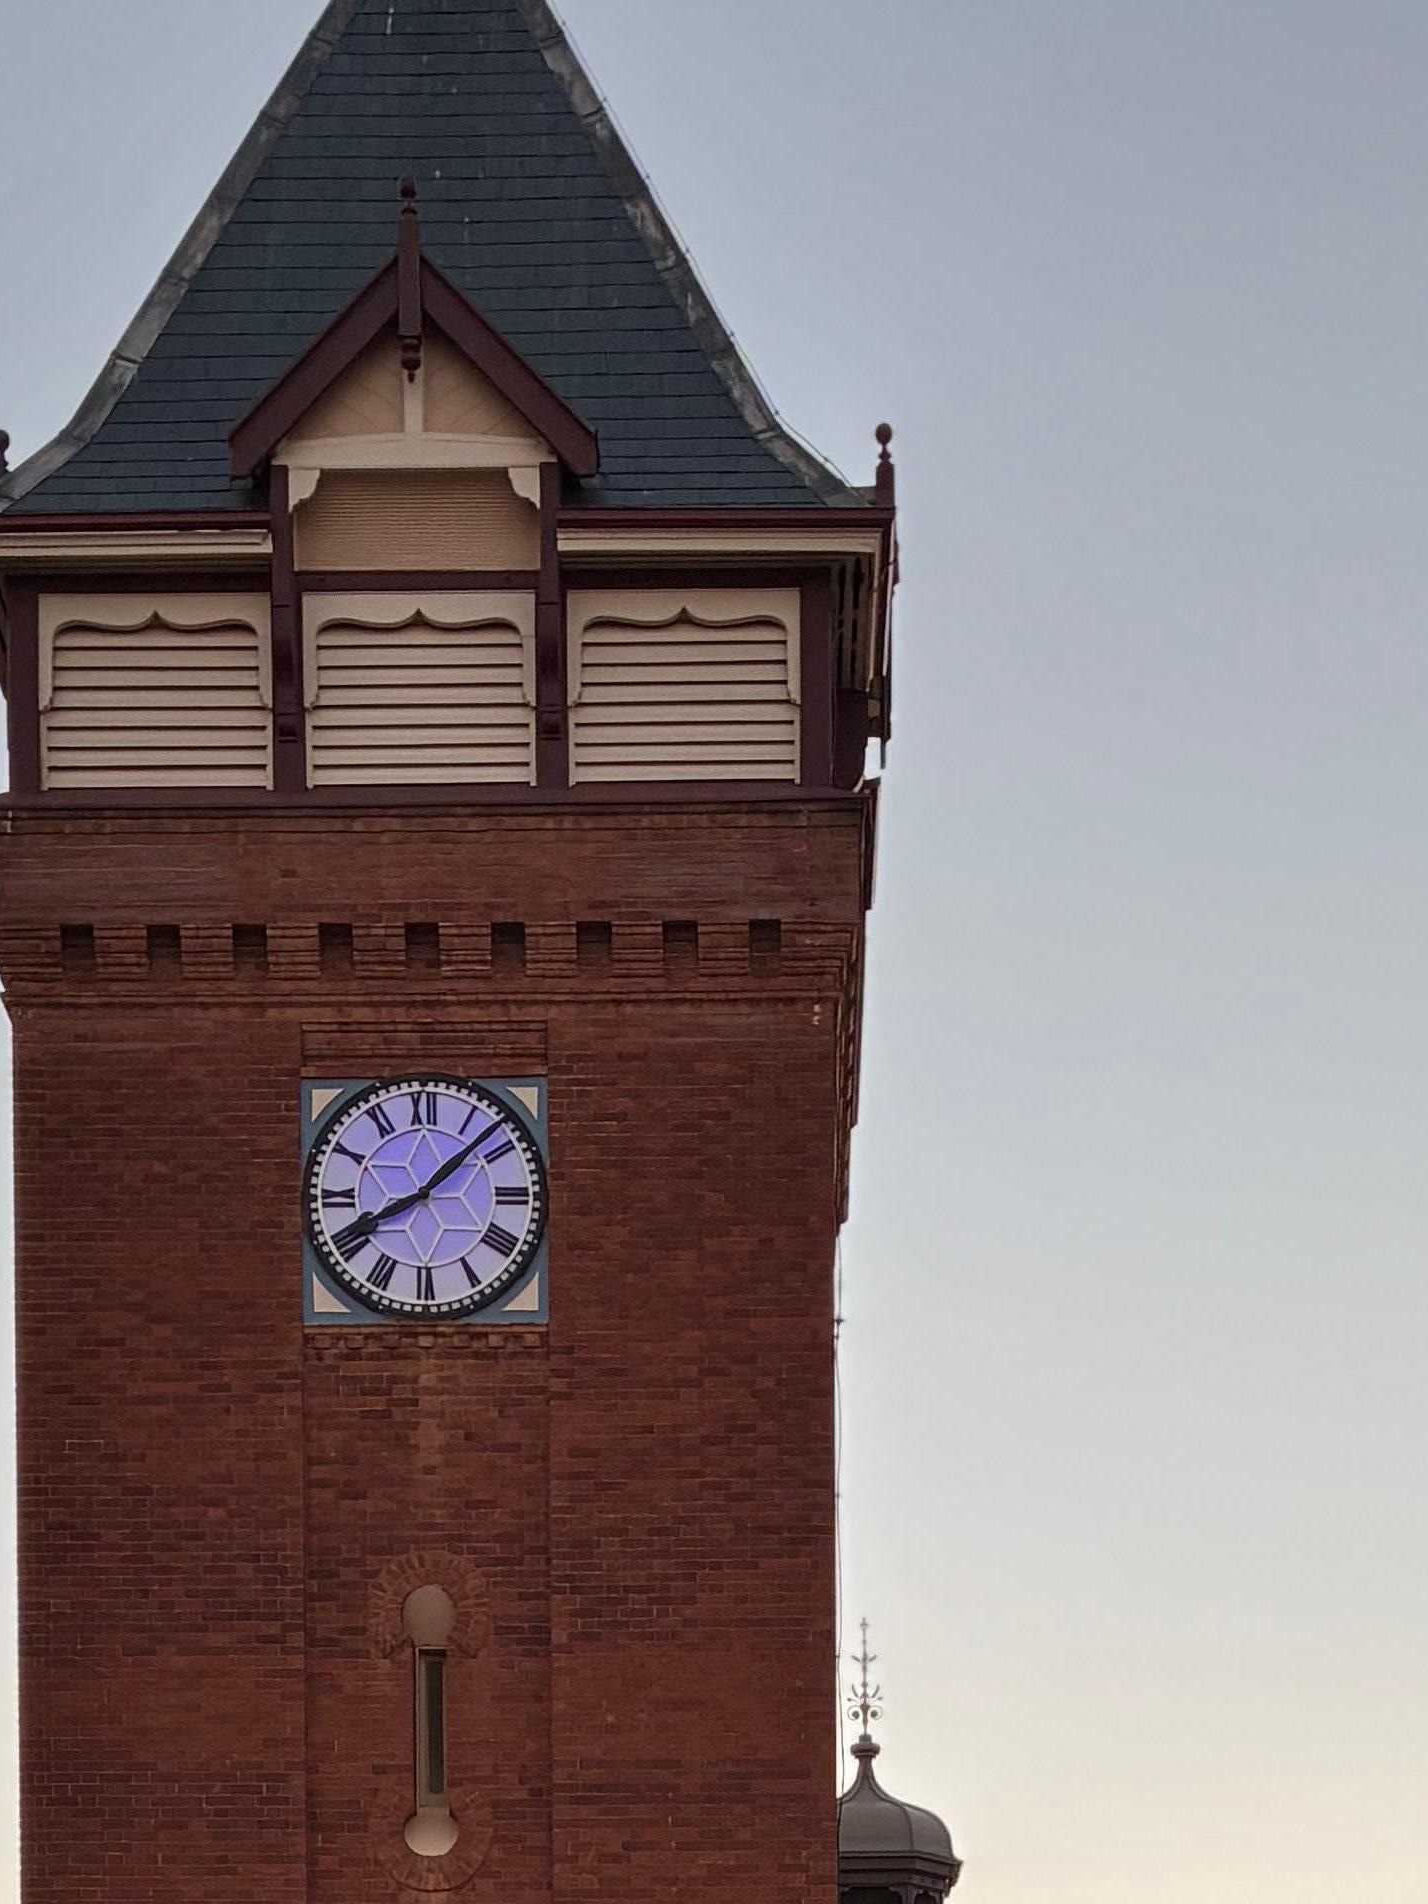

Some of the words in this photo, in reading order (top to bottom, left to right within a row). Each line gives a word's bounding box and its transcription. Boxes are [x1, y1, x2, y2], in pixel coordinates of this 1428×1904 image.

[365, 1103, 396, 1139] XI
[410, 1092, 437, 1126] XII
[459, 1106, 477, 1135] I
[332, 1143, 366, 1165] X
[483, 1139, 515, 1163] II
[322, 1188, 355, 1207] IX
[495, 1186, 529, 1205] III
[366, 1254, 397, 1291] VII
[416, 1267, 436, 1300] VI
[460, 1257, 482, 1288] V
